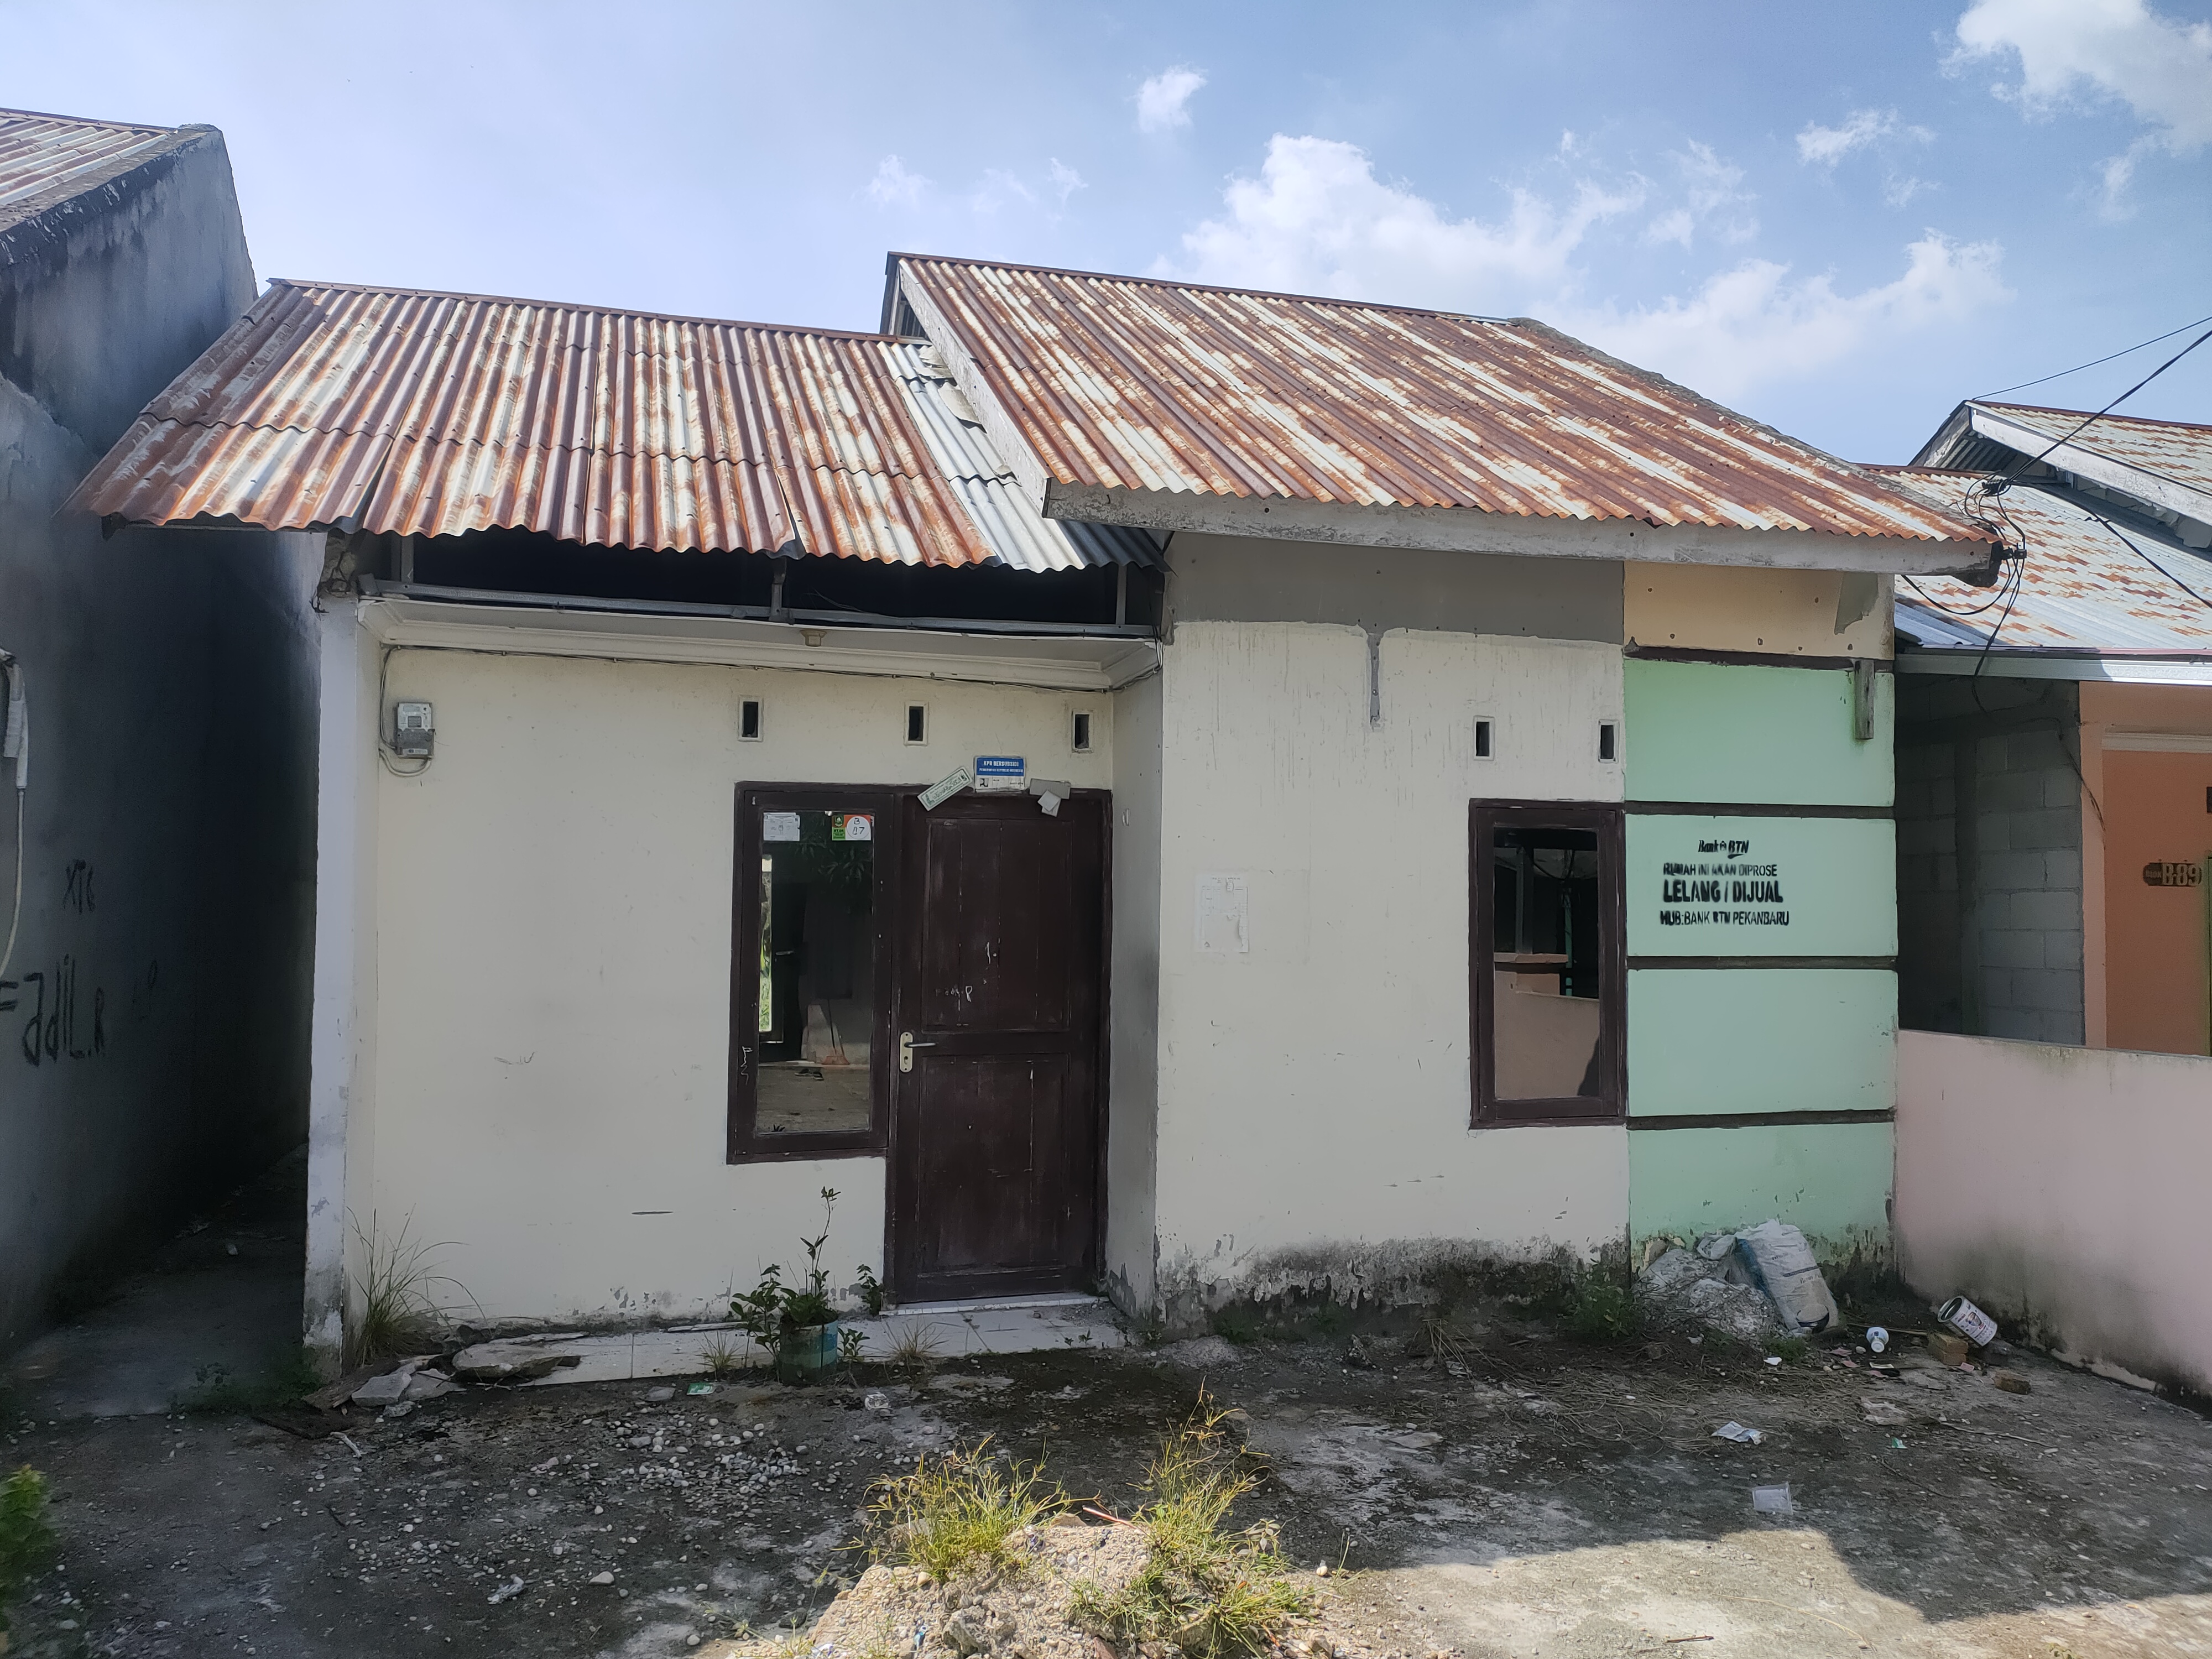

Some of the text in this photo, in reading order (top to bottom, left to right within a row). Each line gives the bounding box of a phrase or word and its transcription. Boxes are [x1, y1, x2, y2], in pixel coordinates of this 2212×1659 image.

[1729, 839, 1749, 854] BTN
[1698, 864, 1709, 876] INI
[1739, 864, 1777, 877] DIPROSE
[1663, 879, 1721, 902] LELANG
[1733, 880, 1783, 902] DIJUAL
[1733, 911, 1790, 926] PEKANBARU
